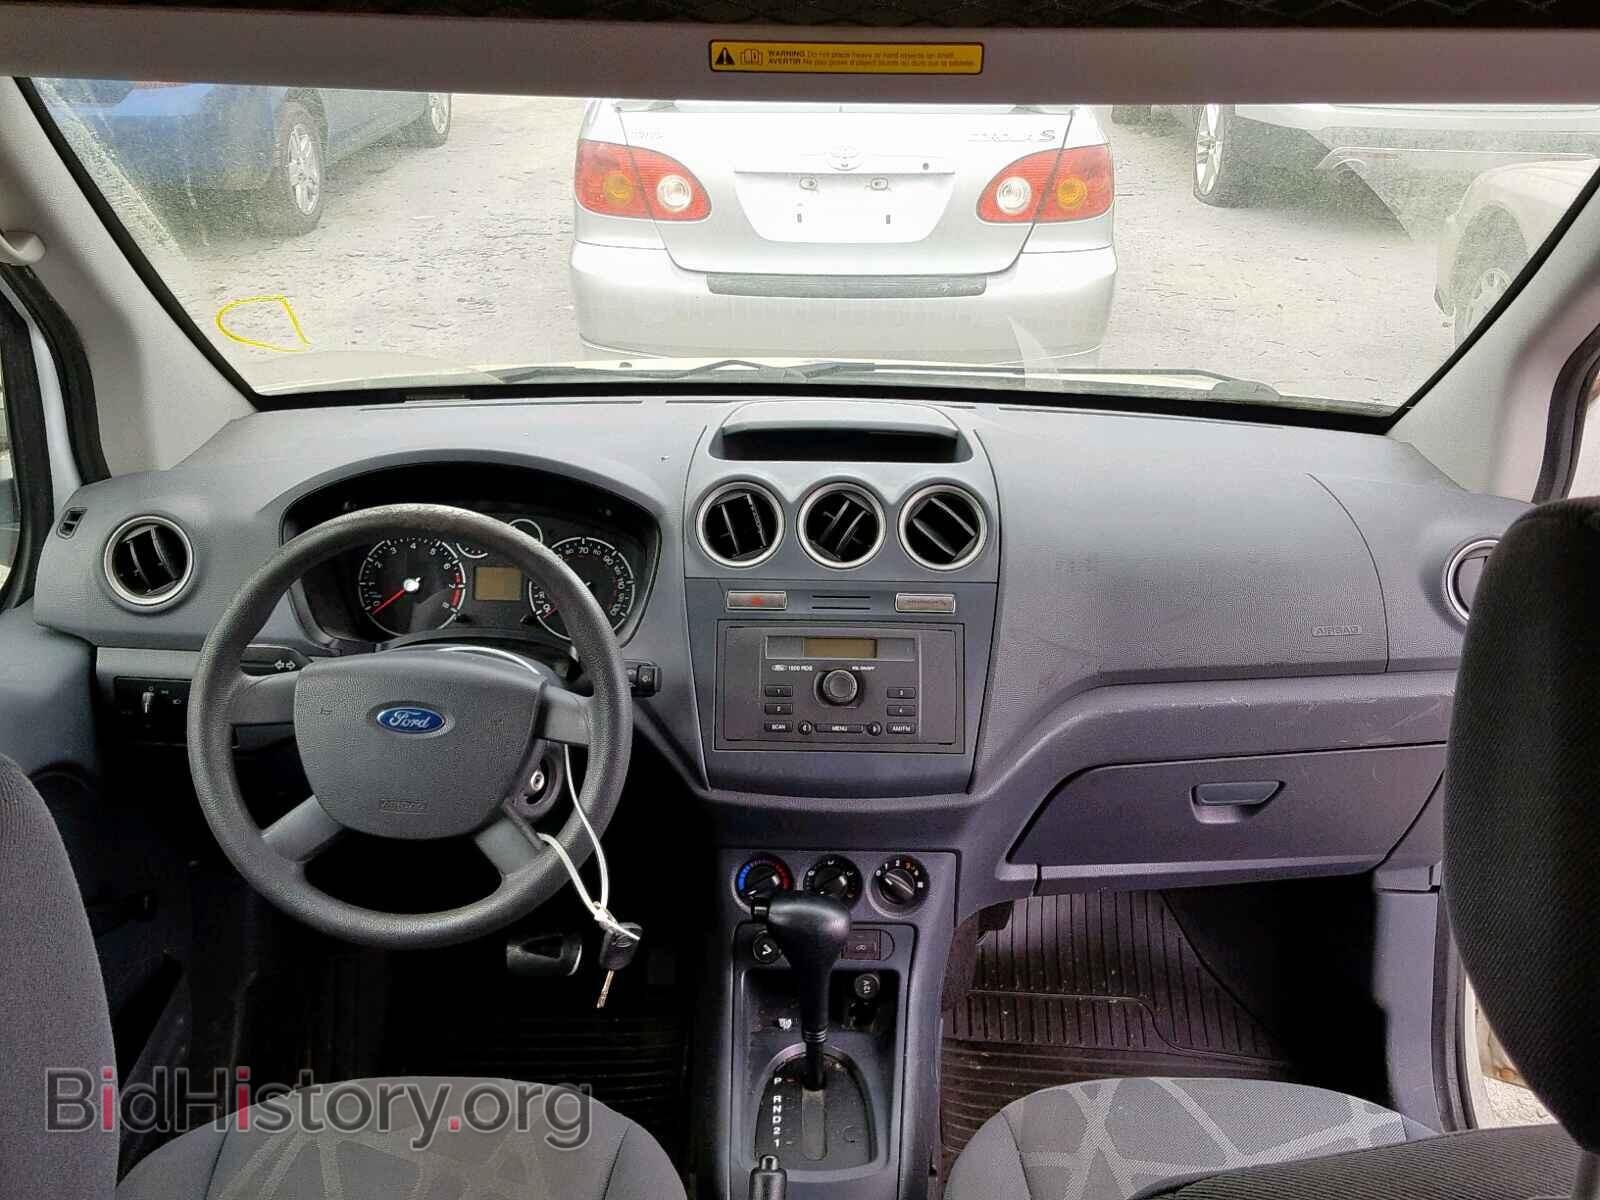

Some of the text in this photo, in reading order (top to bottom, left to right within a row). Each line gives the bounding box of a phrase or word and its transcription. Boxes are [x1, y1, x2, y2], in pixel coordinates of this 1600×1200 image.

[768, 50, 806, 58] WARNING
[1039, 128, 1057, 143] S
[390, 546, 397, 554] 3
[410, 542, 417, 550] 4
[578, 546, 589, 554] 70
[374, 561, 382, 569] 2
[389, 710, 431, 729] Ford
[774, 1077, 782, 1085] P
[773, 1095, 782, 1103] R
[772, 1105, 782, 1113] N
[772, 1116, 782, 1124] D
[773, 1126, 781, 1135] 2
[773, 1138, 780, 1147] 1
